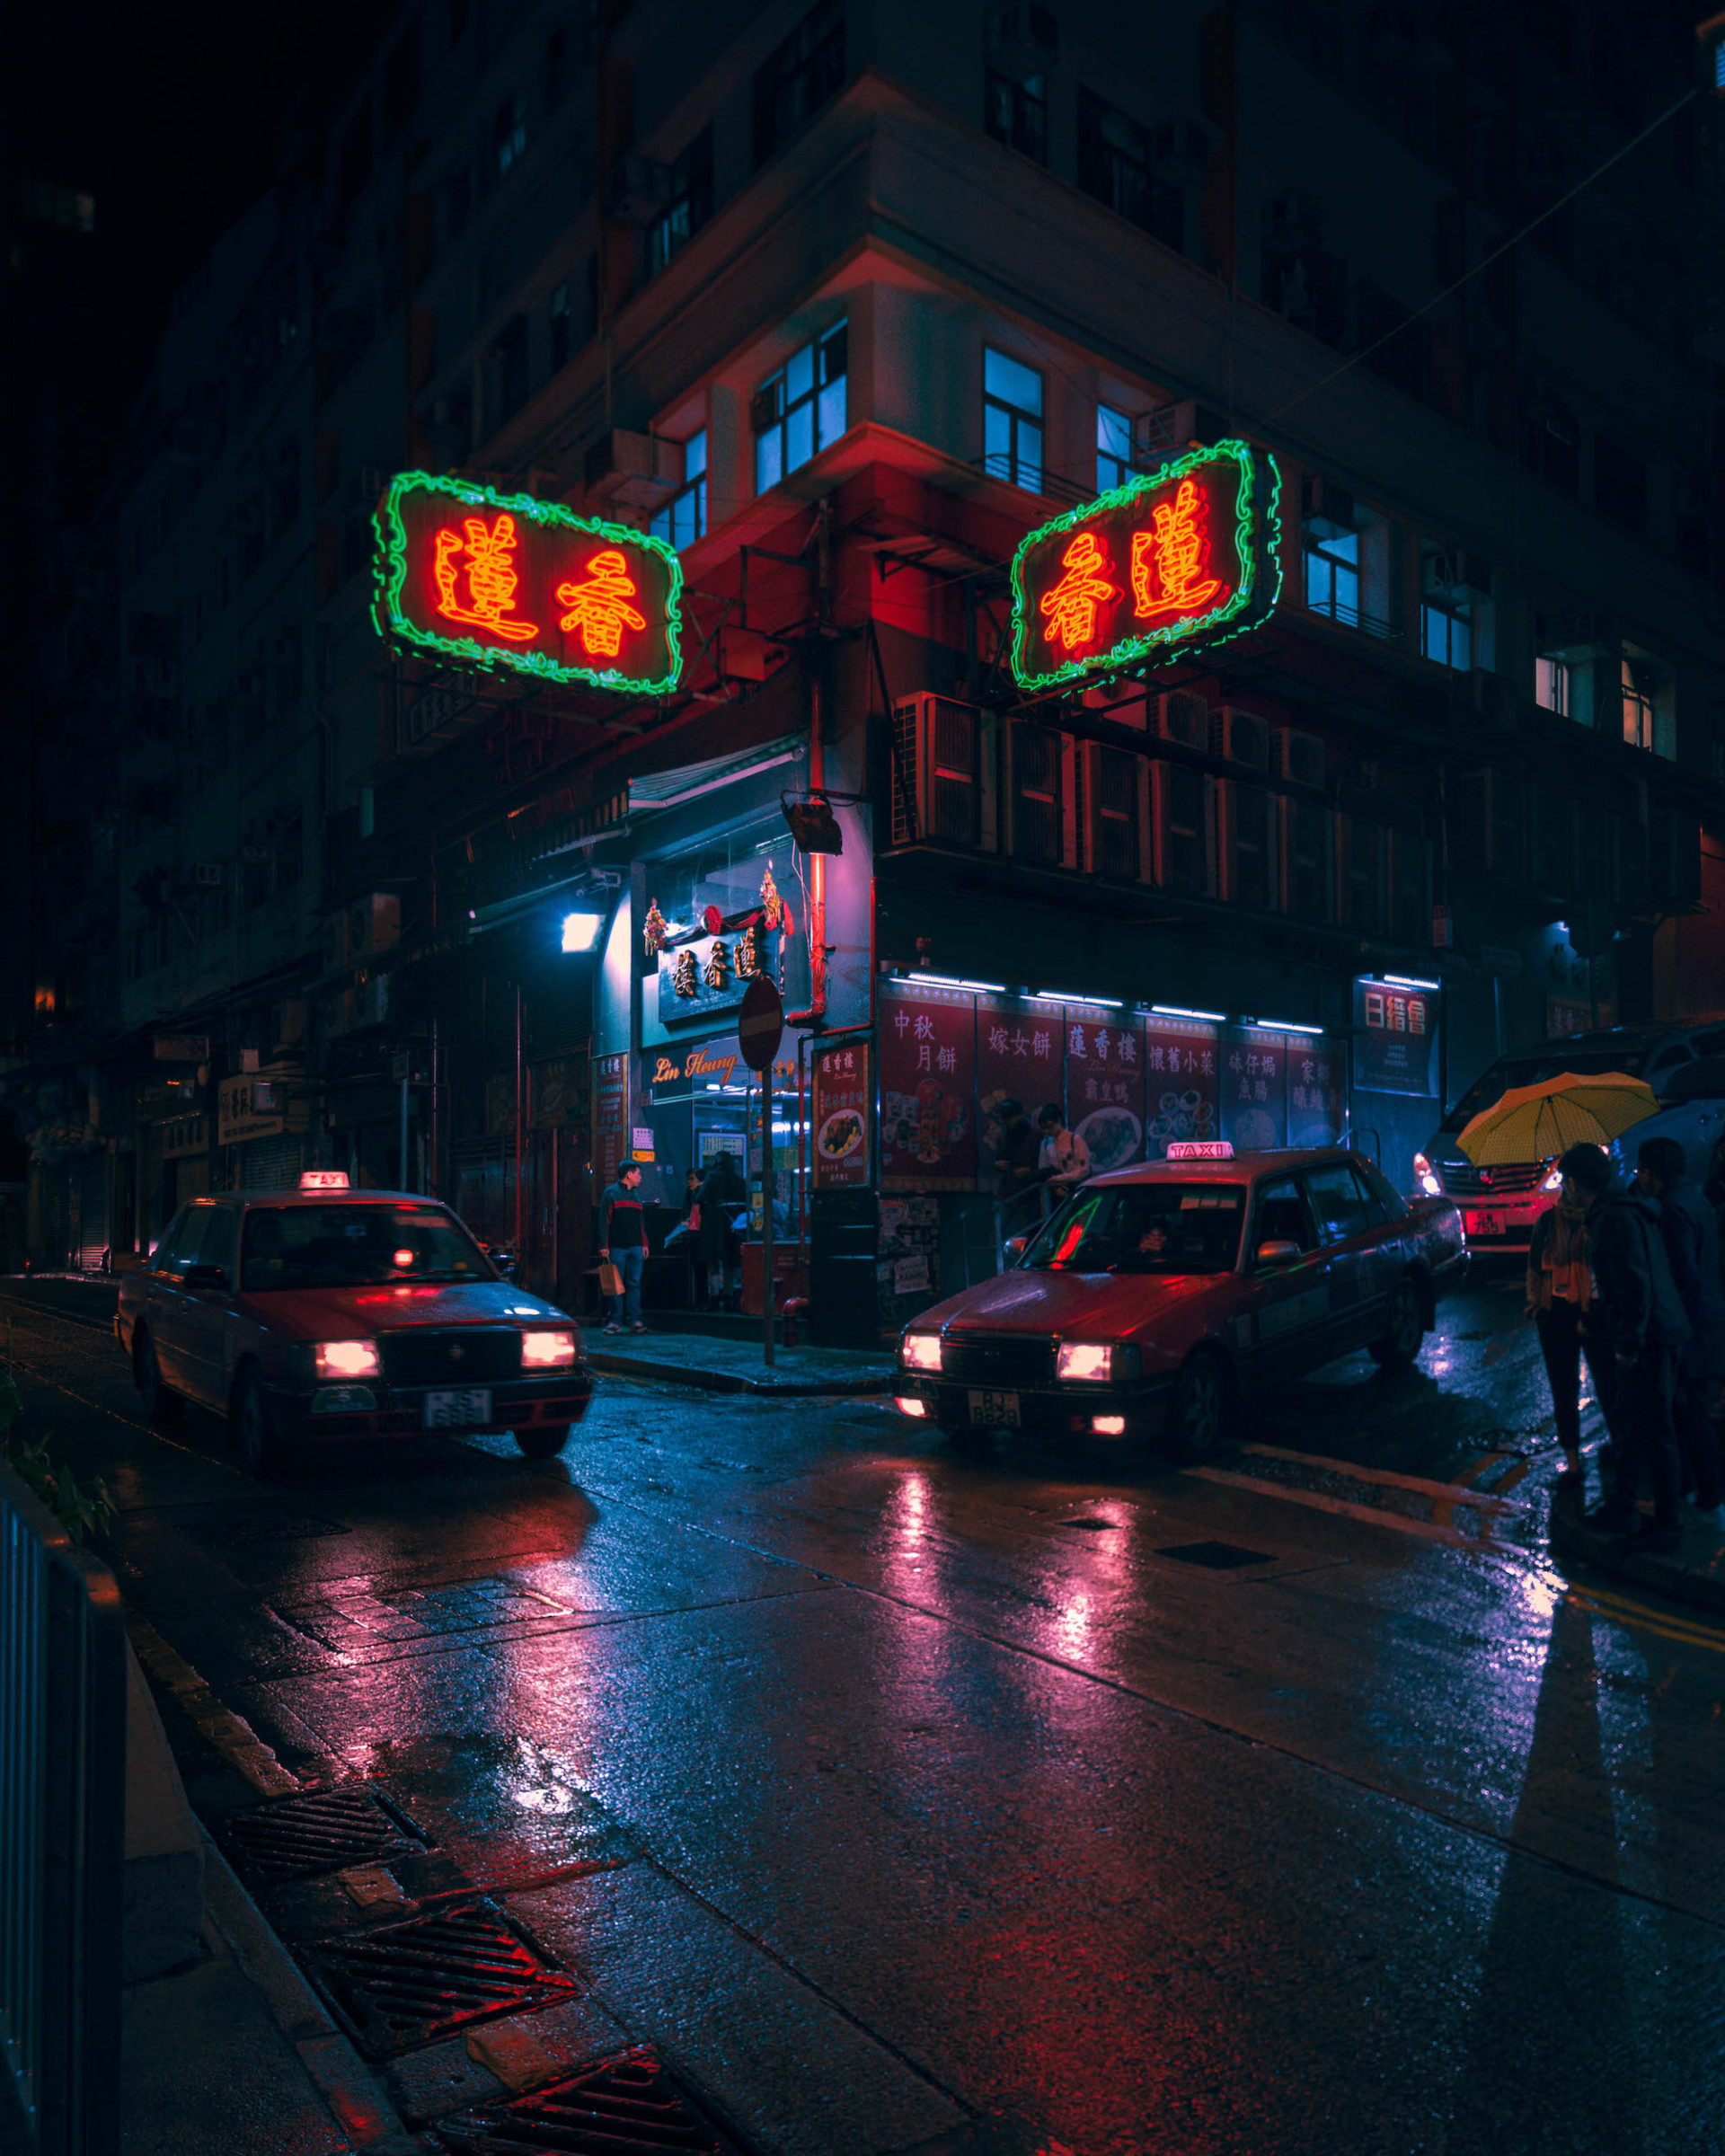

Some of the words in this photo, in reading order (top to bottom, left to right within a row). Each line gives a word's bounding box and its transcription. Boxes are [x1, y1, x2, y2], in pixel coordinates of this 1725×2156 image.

[435, 514, 647, 658] 蓮香
[894, 1010, 935, 1040] 中秋
[988, 1027, 1051, 1060] 嫁女餅
[1069, 1024, 1137, 1064] 蓮香樓
[652, 1056, 680, 1083] Lin
[684, 1047, 738, 1083] Heung
[822, 1051, 854, 1073] 蓮香樓
[916, 1045, 957, 1074] 月餅
[1149, 1046, 1216, 1077] 懷舊小菜
[1171, 1144, 1225, 1159] TAXI
